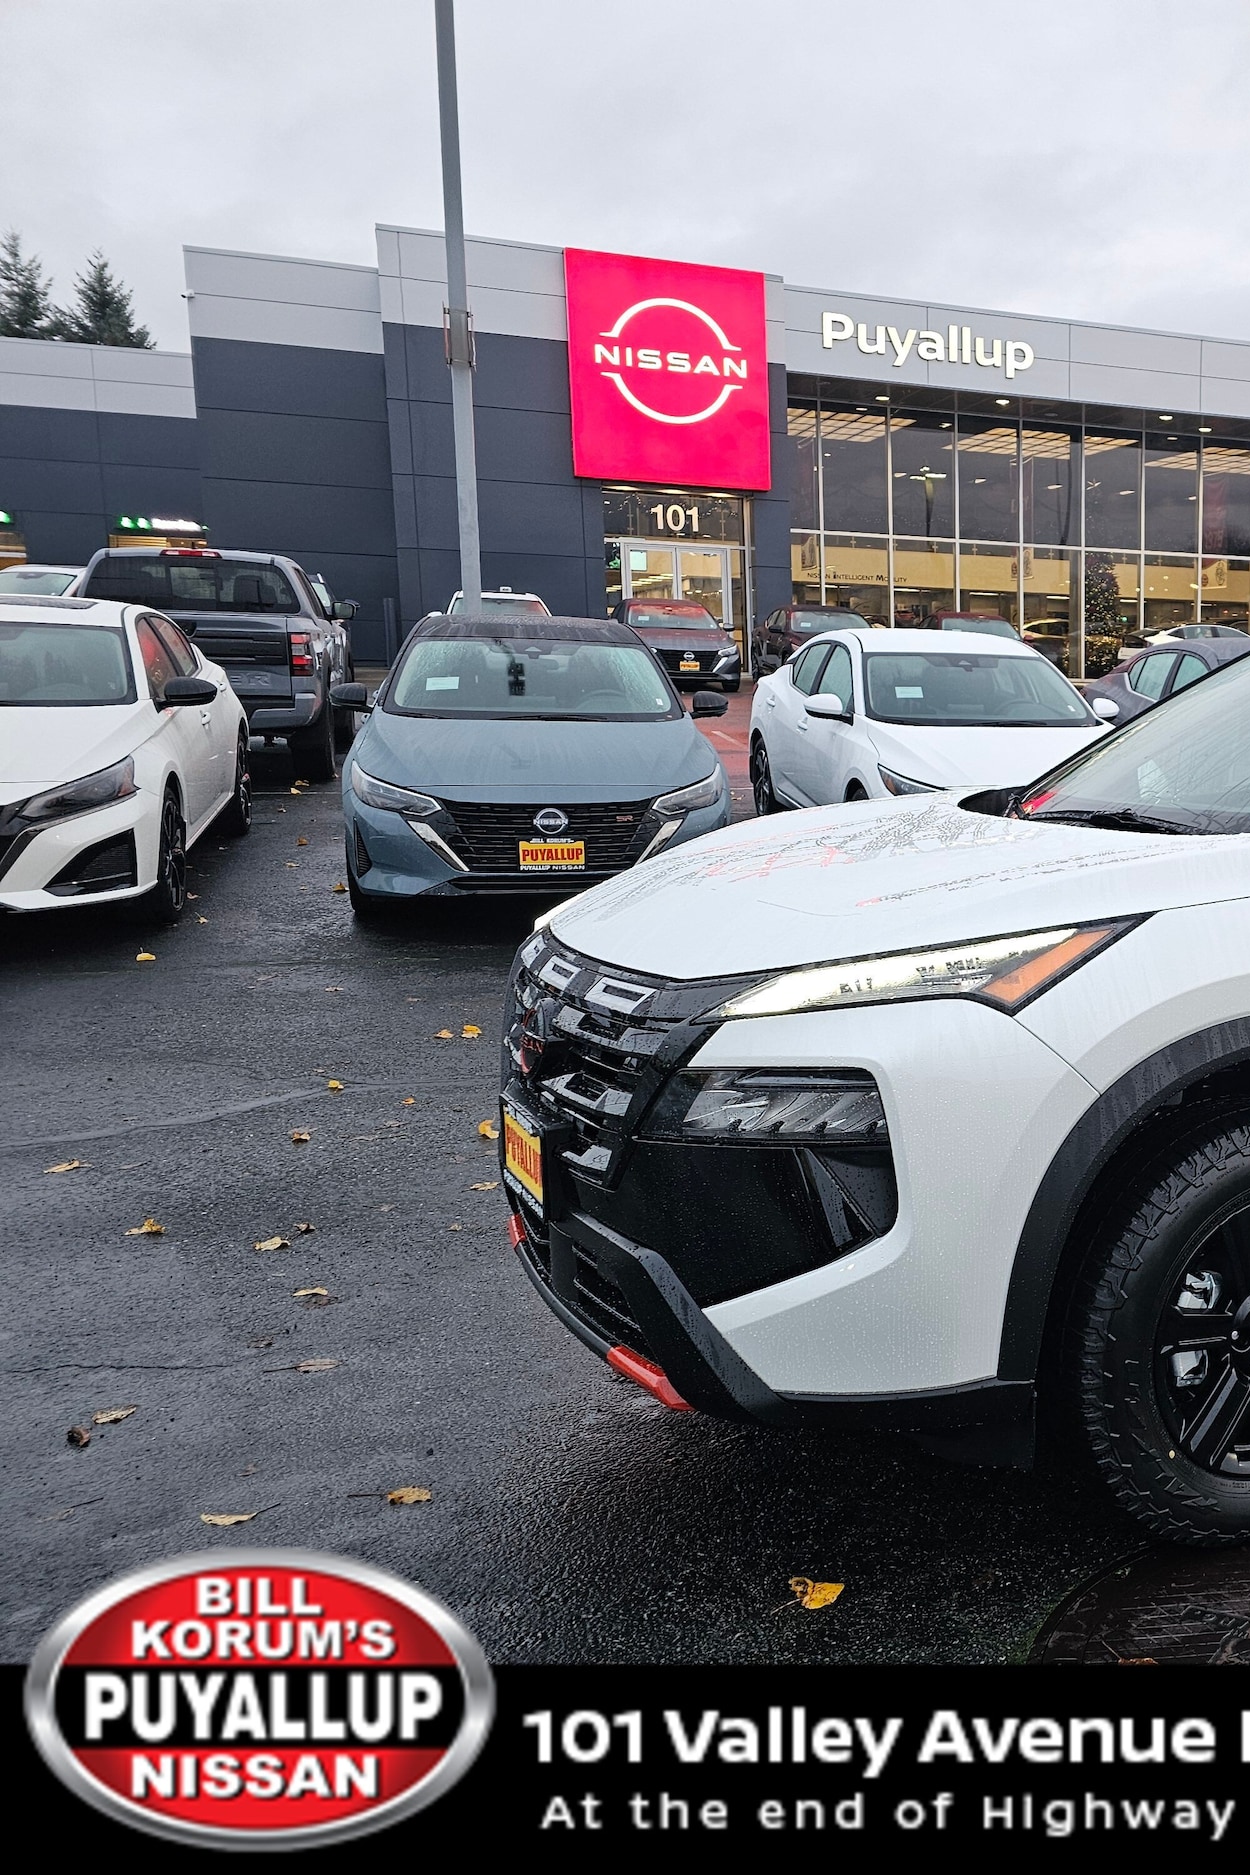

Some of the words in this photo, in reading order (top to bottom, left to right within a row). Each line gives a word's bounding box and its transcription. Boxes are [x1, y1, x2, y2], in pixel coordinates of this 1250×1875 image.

[822, 311, 1035, 379] Puyallup
[594, 343, 748, 379] NISSAN
[651, 504, 700, 533] 101
[875, 574, 908, 583] MOLITY
[533, 818, 569, 826] NISSAN
[522, 848, 583, 862] PUYALLUP
